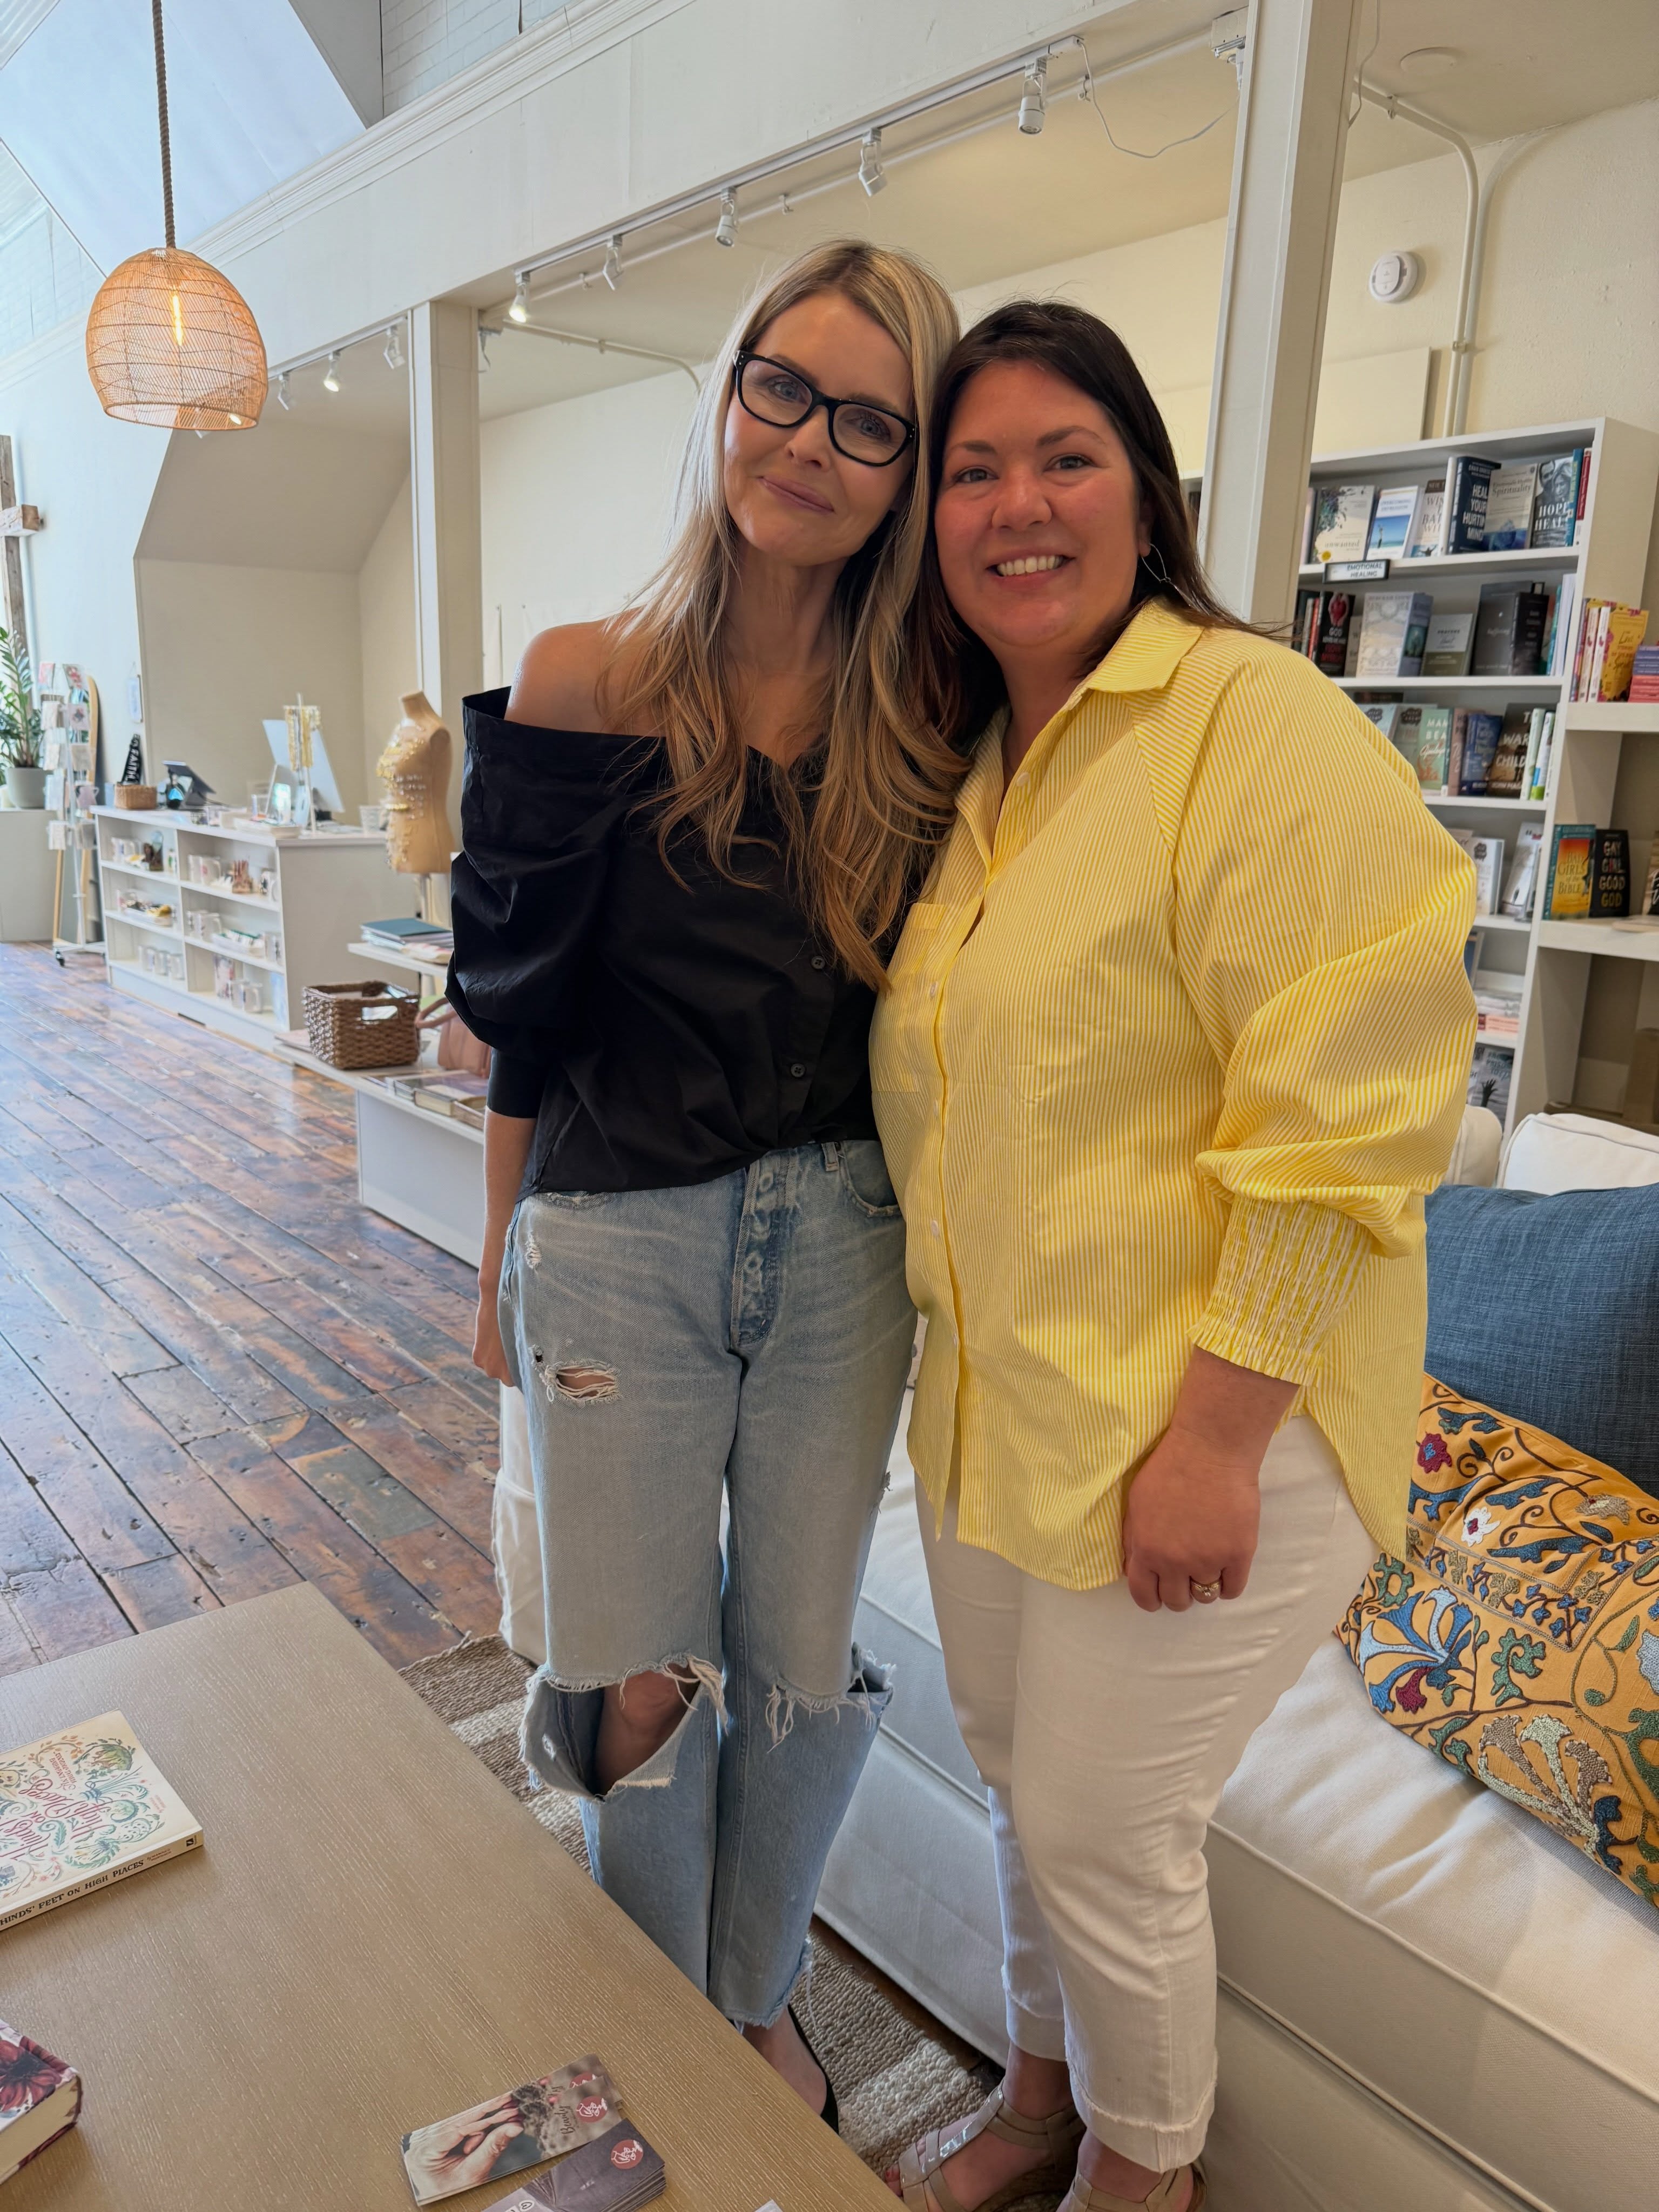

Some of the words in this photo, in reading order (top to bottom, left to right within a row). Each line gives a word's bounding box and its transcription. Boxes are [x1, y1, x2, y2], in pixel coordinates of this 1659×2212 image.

[1462, 511, 1486, 527] HURTIN
[1535, 517, 1567, 530] HEAL
[1346, 561, 1382, 571] EMOTIONAL
[1426, 731, 1446, 740] BEA
[1495, 754, 1526, 767] CHILD
[1557, 862, 1586, 875] GIRLS
[1558, 881, 1580, 895] BIBLE
[1599, 875, 1625, 891] GOOD
[1601, 892, 1622, 907] GOD
[18, 1778, 87, 1818] Places
[67, 1887, 80, 1897] ON
[84, 1875, 108, 1890] HIGH
[112, 1859, 144, 1878] PLACES
